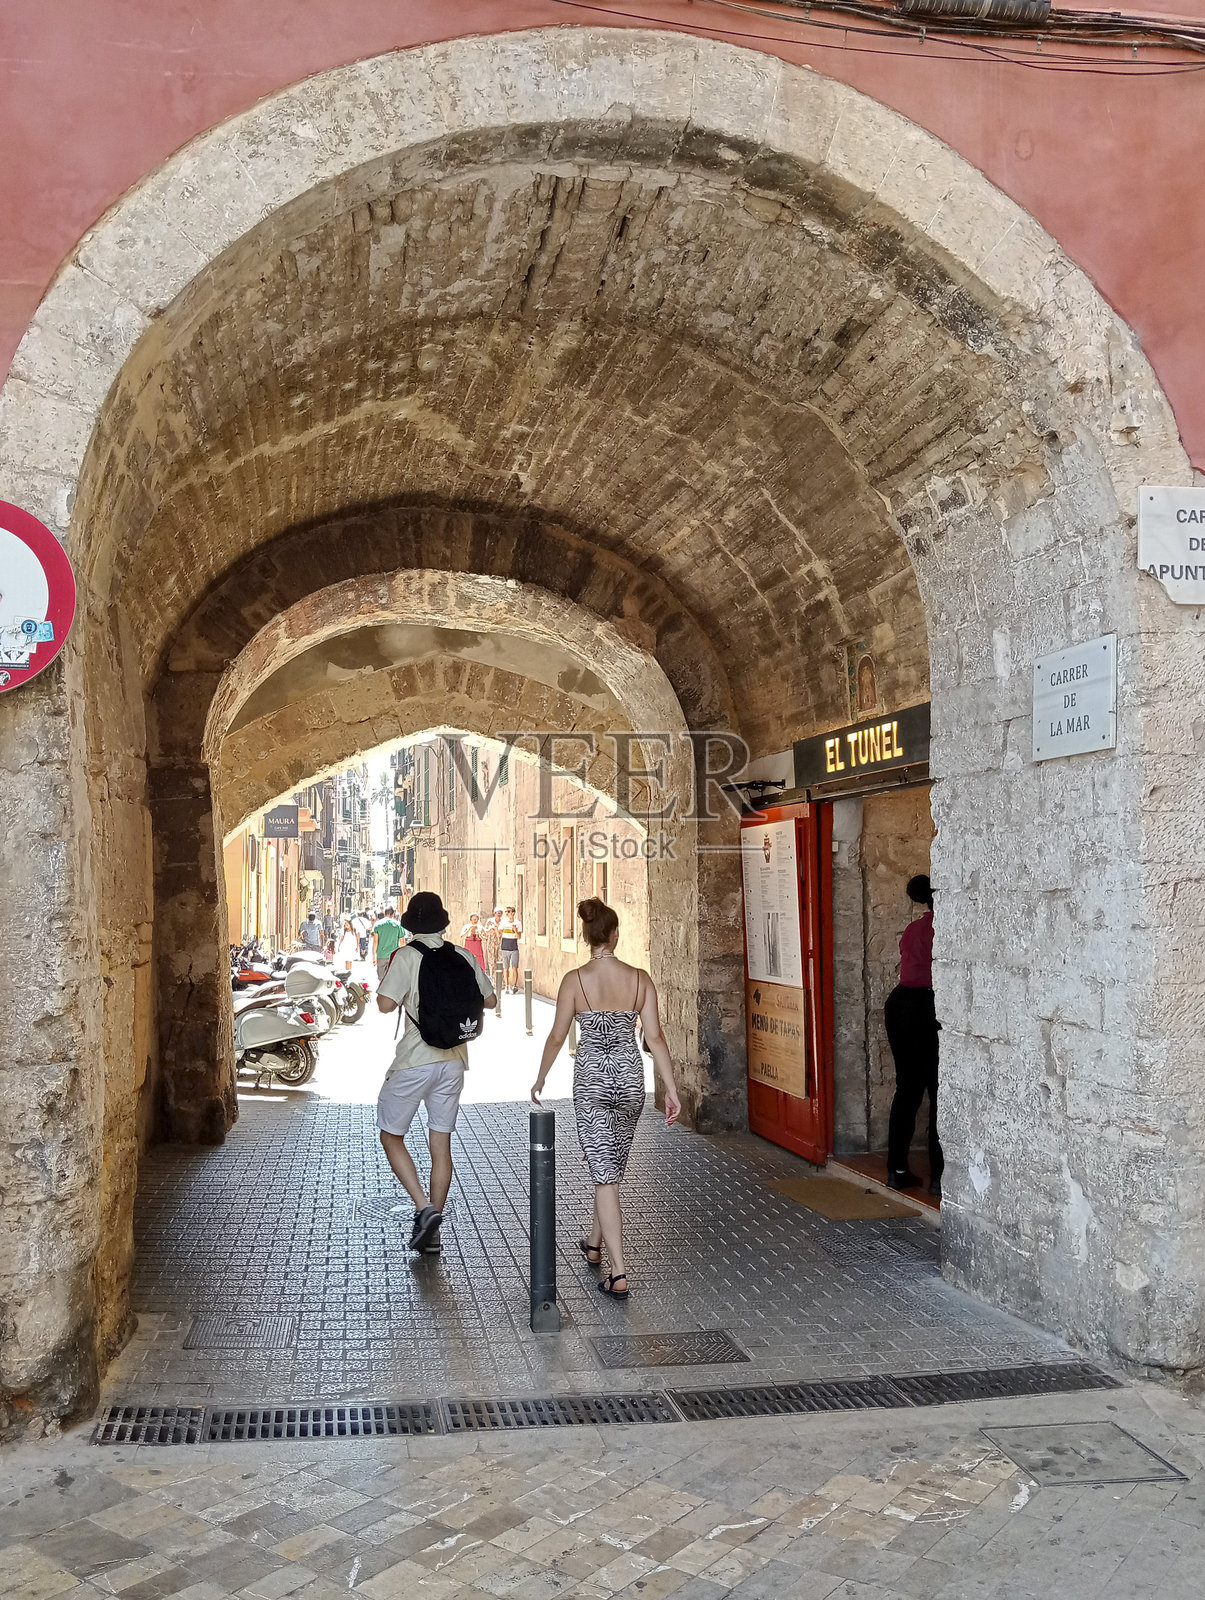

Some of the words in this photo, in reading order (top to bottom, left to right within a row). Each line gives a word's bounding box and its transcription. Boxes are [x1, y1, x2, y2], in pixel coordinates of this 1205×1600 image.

[1050, 663, 1089, 687] CARRER
[1063, 692, 1077, 709] DE
[1050, 720, 1063, 738] LA
[1066, 714, 1091, 734] MAR
[825, 737, 845, 773] EL
[847, 720, 904, 768] TUNEL
[458, 1032, 477, 1040] adidas
